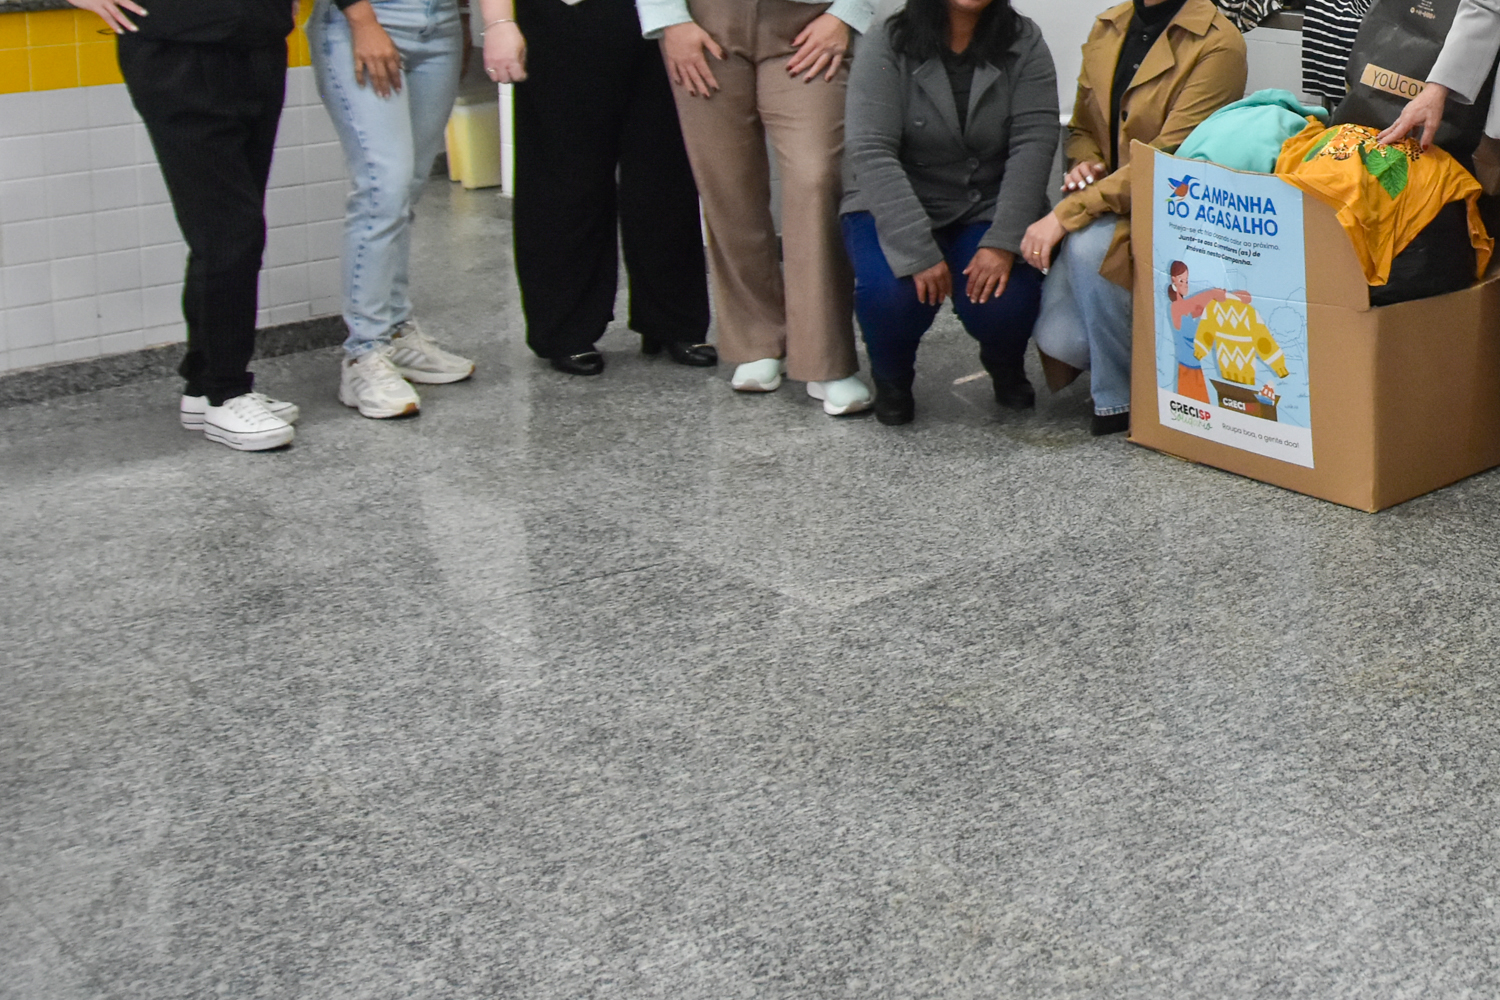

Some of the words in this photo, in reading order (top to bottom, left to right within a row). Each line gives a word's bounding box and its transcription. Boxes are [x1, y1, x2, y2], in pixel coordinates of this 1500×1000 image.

[1371, 70, 1424, 97] YOUCO
[1189, 182, 1277, 216] CAMPANHA
[1167, 200, 1190, 219] DO
[1194, 204, 1279, 237] AGASALHO
